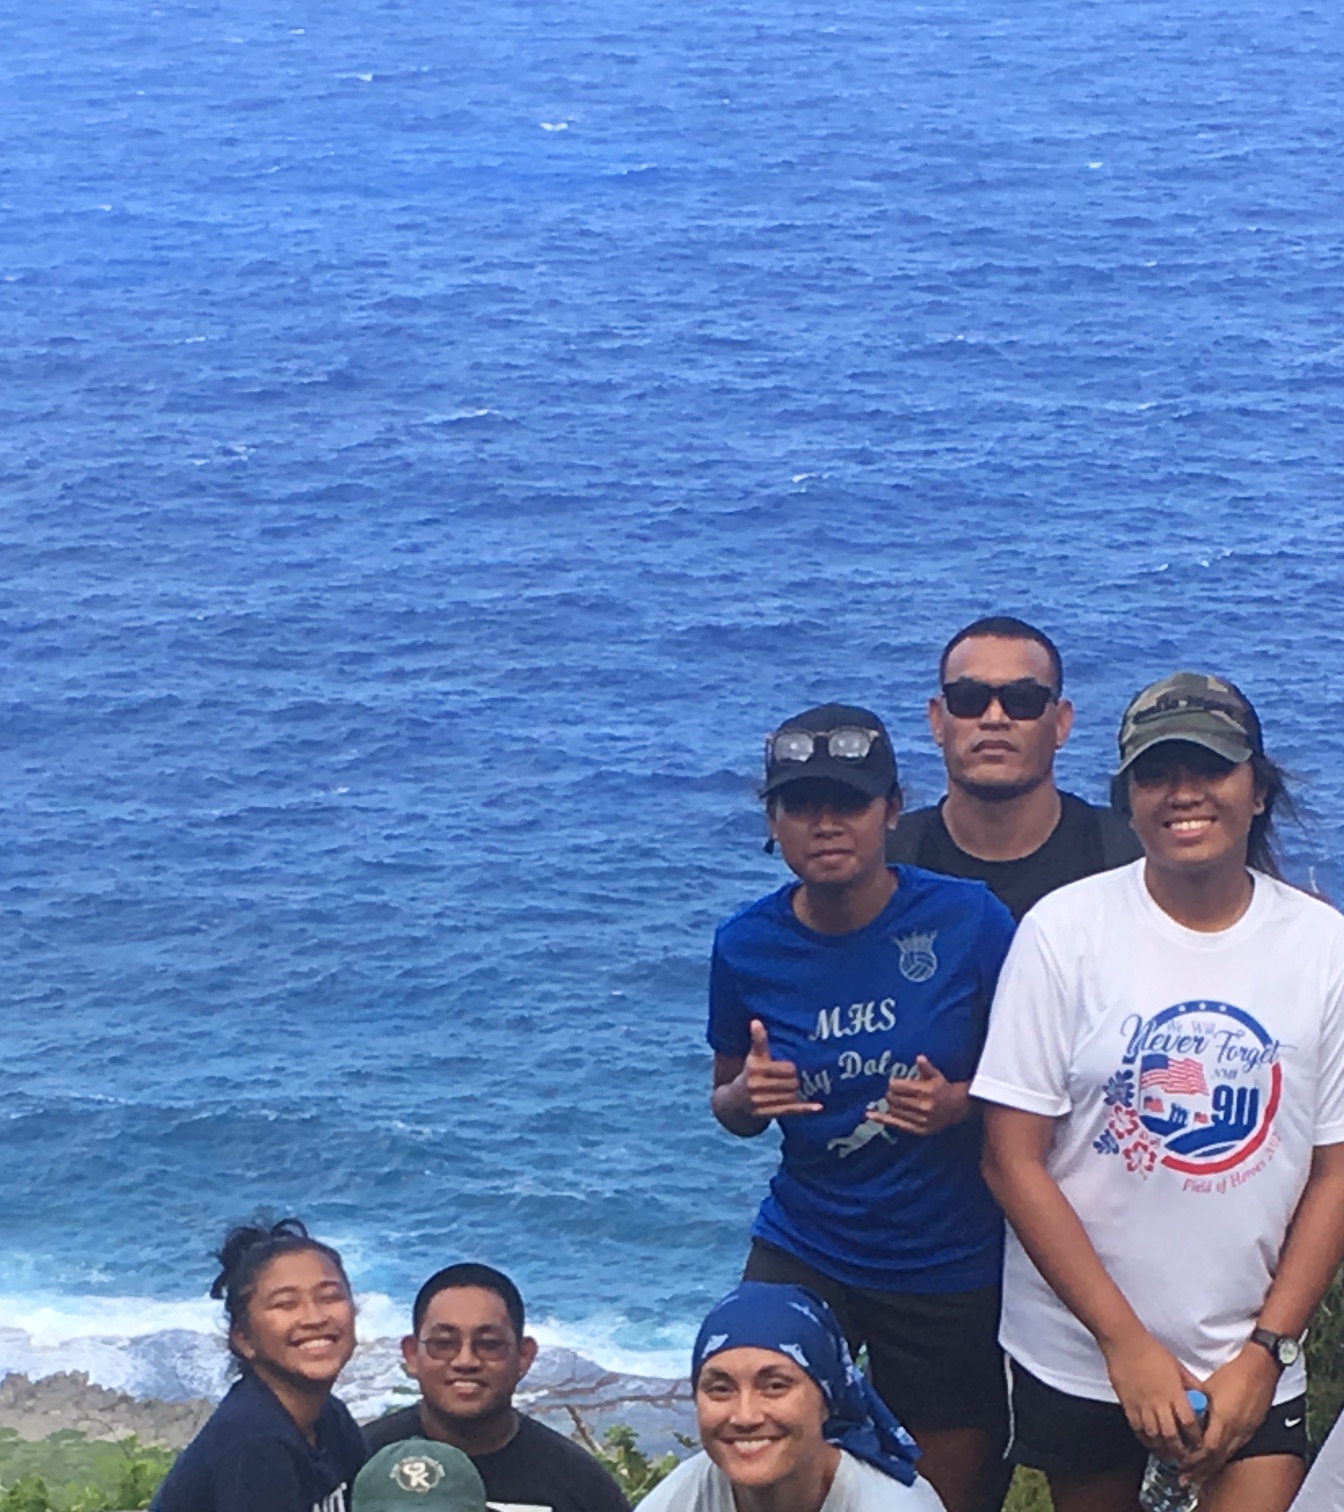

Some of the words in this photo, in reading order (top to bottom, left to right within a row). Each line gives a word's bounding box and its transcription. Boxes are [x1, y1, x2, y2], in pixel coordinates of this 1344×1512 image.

[808, 998, 896, 1041] MHS
[1120, 1014, 1208, 1060] Never
[1212, 1029, 1298, 1073] Forget
